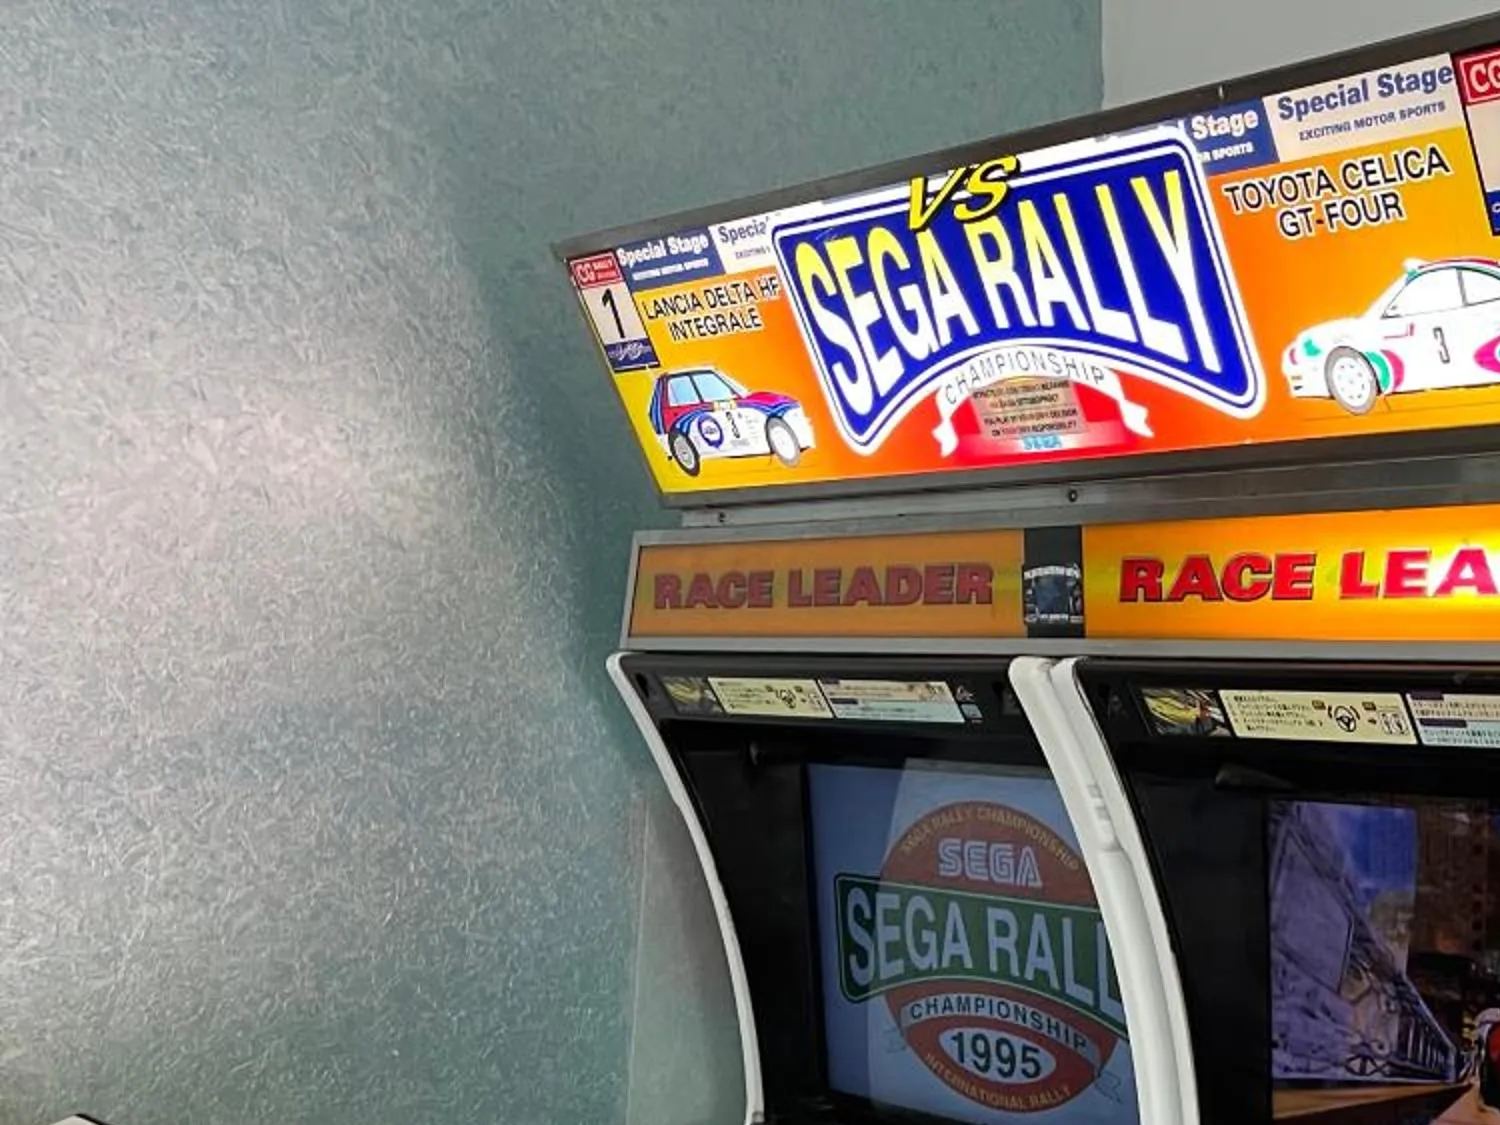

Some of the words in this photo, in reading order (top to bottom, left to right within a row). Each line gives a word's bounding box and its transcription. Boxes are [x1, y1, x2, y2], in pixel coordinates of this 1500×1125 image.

[1277, 78, 1369, 121] Special
[1376, 65, 1455, 99] Stage
[1191, 109, 1259, 140] Stage
[1299, 121, 1352, 142] EXCITING
[1353, 111, 1397, 130] MOTOR
[1399, 101, 1447, 121] SPORTS
[1225, 168, 1335, 212] TOYOTA
[1342, 147, 1450, 188] CELICA
[1280, 193, 1406, 237] GT-FOUR
[616, 241, 665, 268] Special
[668, 233, 710, 256] Stage
[601, 287, 626, 339] 1
[642, 293, 704, 321] LANCIA
[705, 280, 755, 312] DELTA
[755, 275, 780, 300] HF
[795, 225, 980, 417] SEGA
[964, 168, 1223, 375] RALLY
[668, 307, 763, 342] INTEGRALE
[1433, 326, 1452, 365] 3
[945, 350, 1106, 405] CHAMPIONSHIP
[654, 572, 775, 610] RACE
[787, 561, 995, 610] LEADER
[1119, 551, 1317, 602] RACE
[938, 837, 1043, 889] SEGA
[847, 886, 975, 988] SEGA
[988, 906, 1128, 1018] RALL
[910, 995, 1088, 1053] CHAMPIONSHIP
[951, 1031, 1042, 1080] 1995
